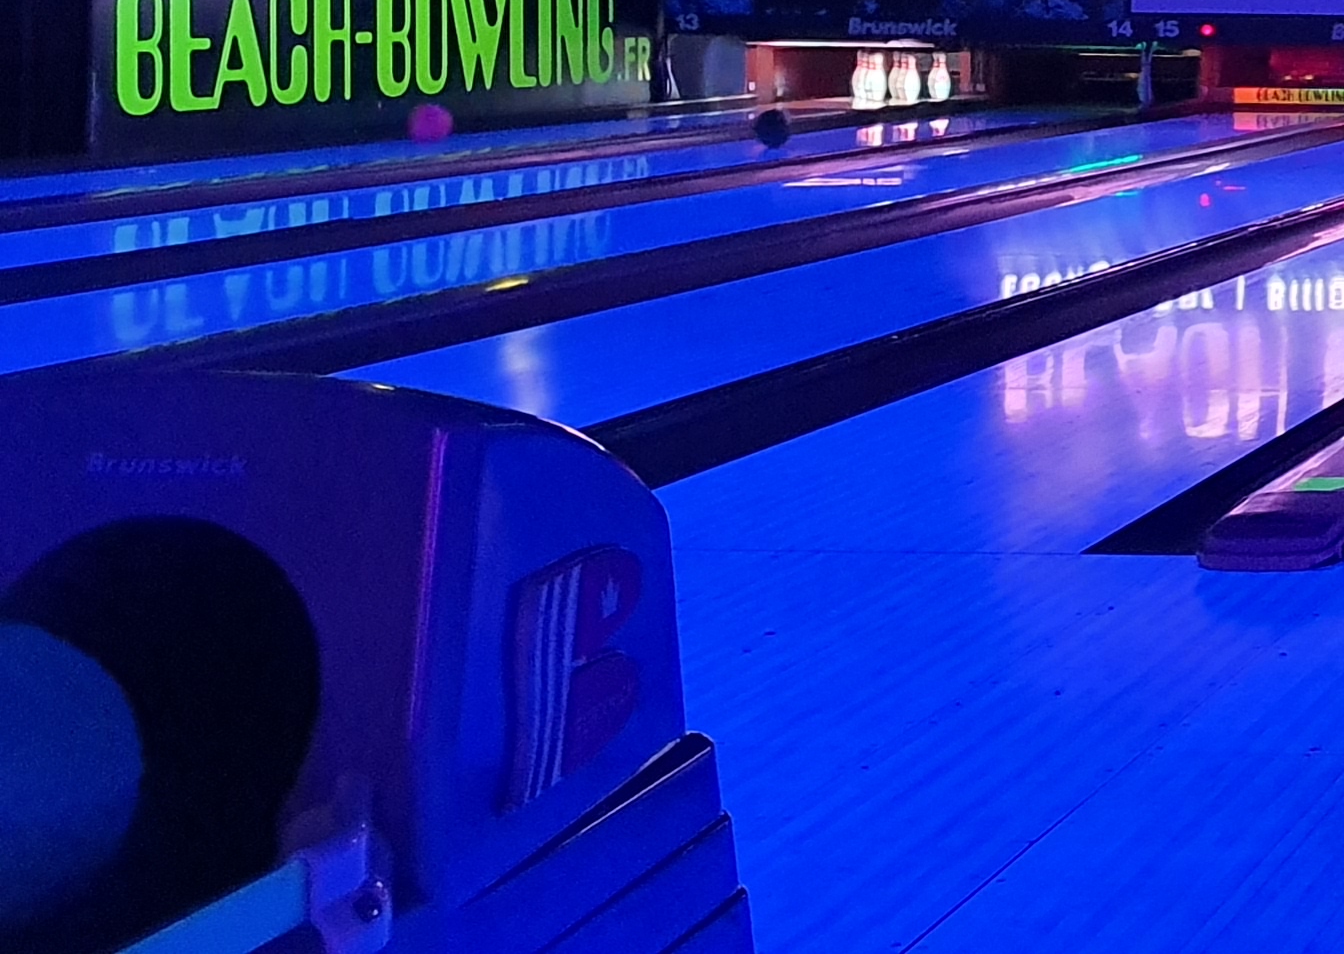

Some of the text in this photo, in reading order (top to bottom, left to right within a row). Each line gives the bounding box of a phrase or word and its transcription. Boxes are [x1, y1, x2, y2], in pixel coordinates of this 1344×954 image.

[676, 13, 700, 31] 13
[848, 17, 958, 36] Brunswick
[1107, 20, 1133, 37] 14
[1154, 20, 1180, 37] 15
